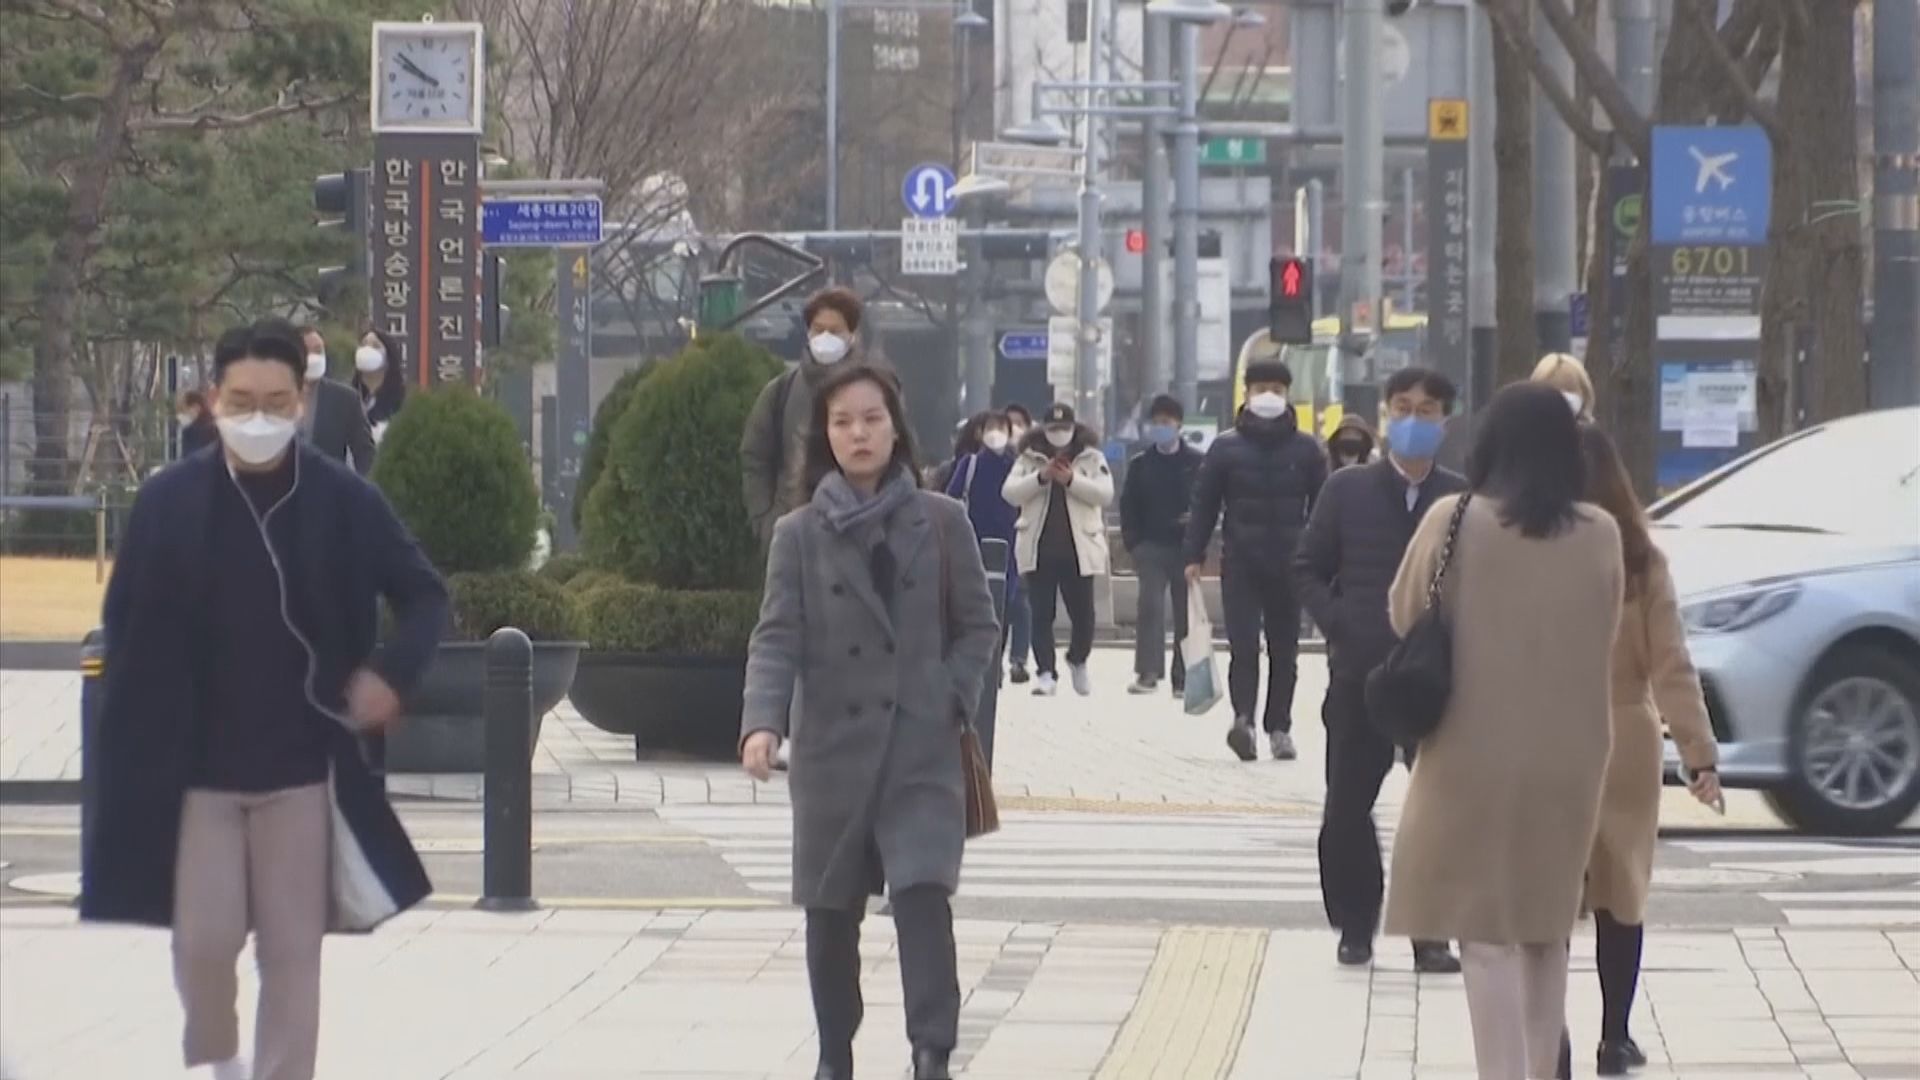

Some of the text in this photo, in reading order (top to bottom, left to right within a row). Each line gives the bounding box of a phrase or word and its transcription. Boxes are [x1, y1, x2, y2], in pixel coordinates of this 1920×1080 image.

[437, 158, 468, 383] 한국언론진흥
[572, 255, 589, 281] 4
[1671, 247, 1748, 275] 6701
